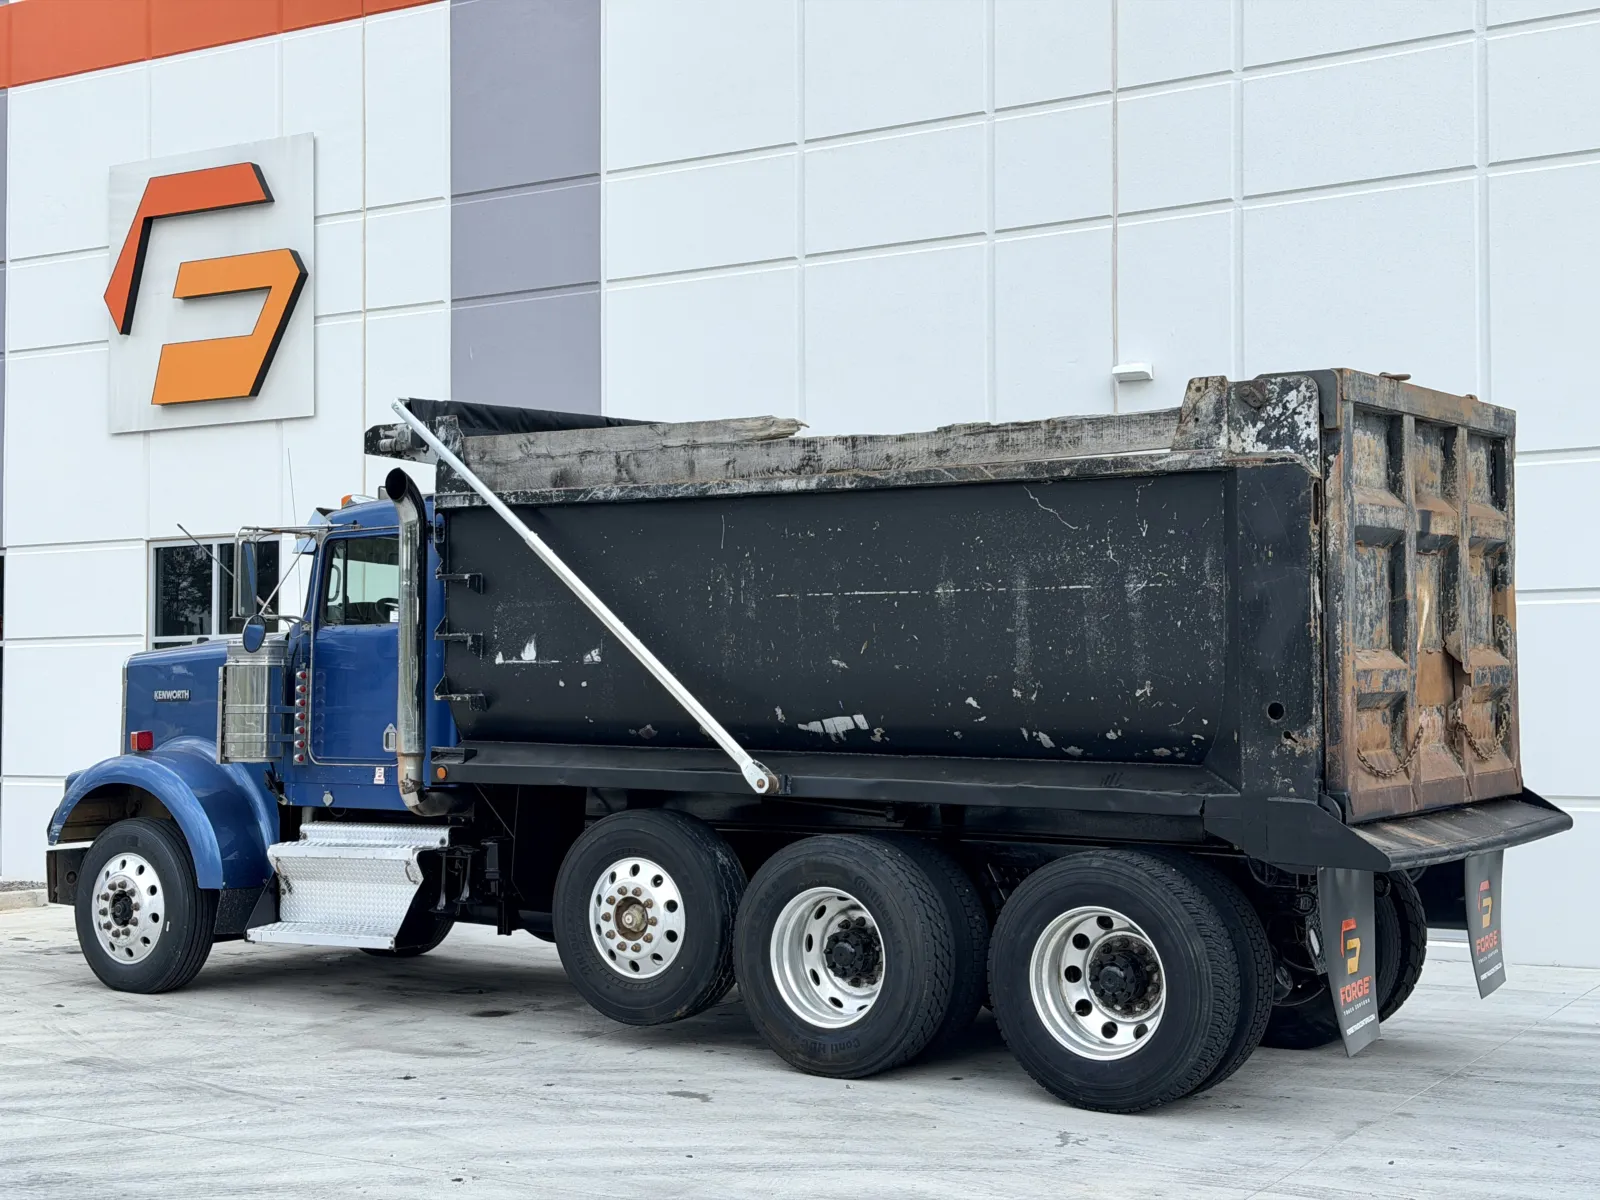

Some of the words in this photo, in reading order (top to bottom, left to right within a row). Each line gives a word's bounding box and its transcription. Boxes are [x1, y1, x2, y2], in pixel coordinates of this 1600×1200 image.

[153, 689, 190, 701] KENWORTH
[1476, 929, 1499, 956] FORGE
[1340, 976, 1371, 1006] FORGE
